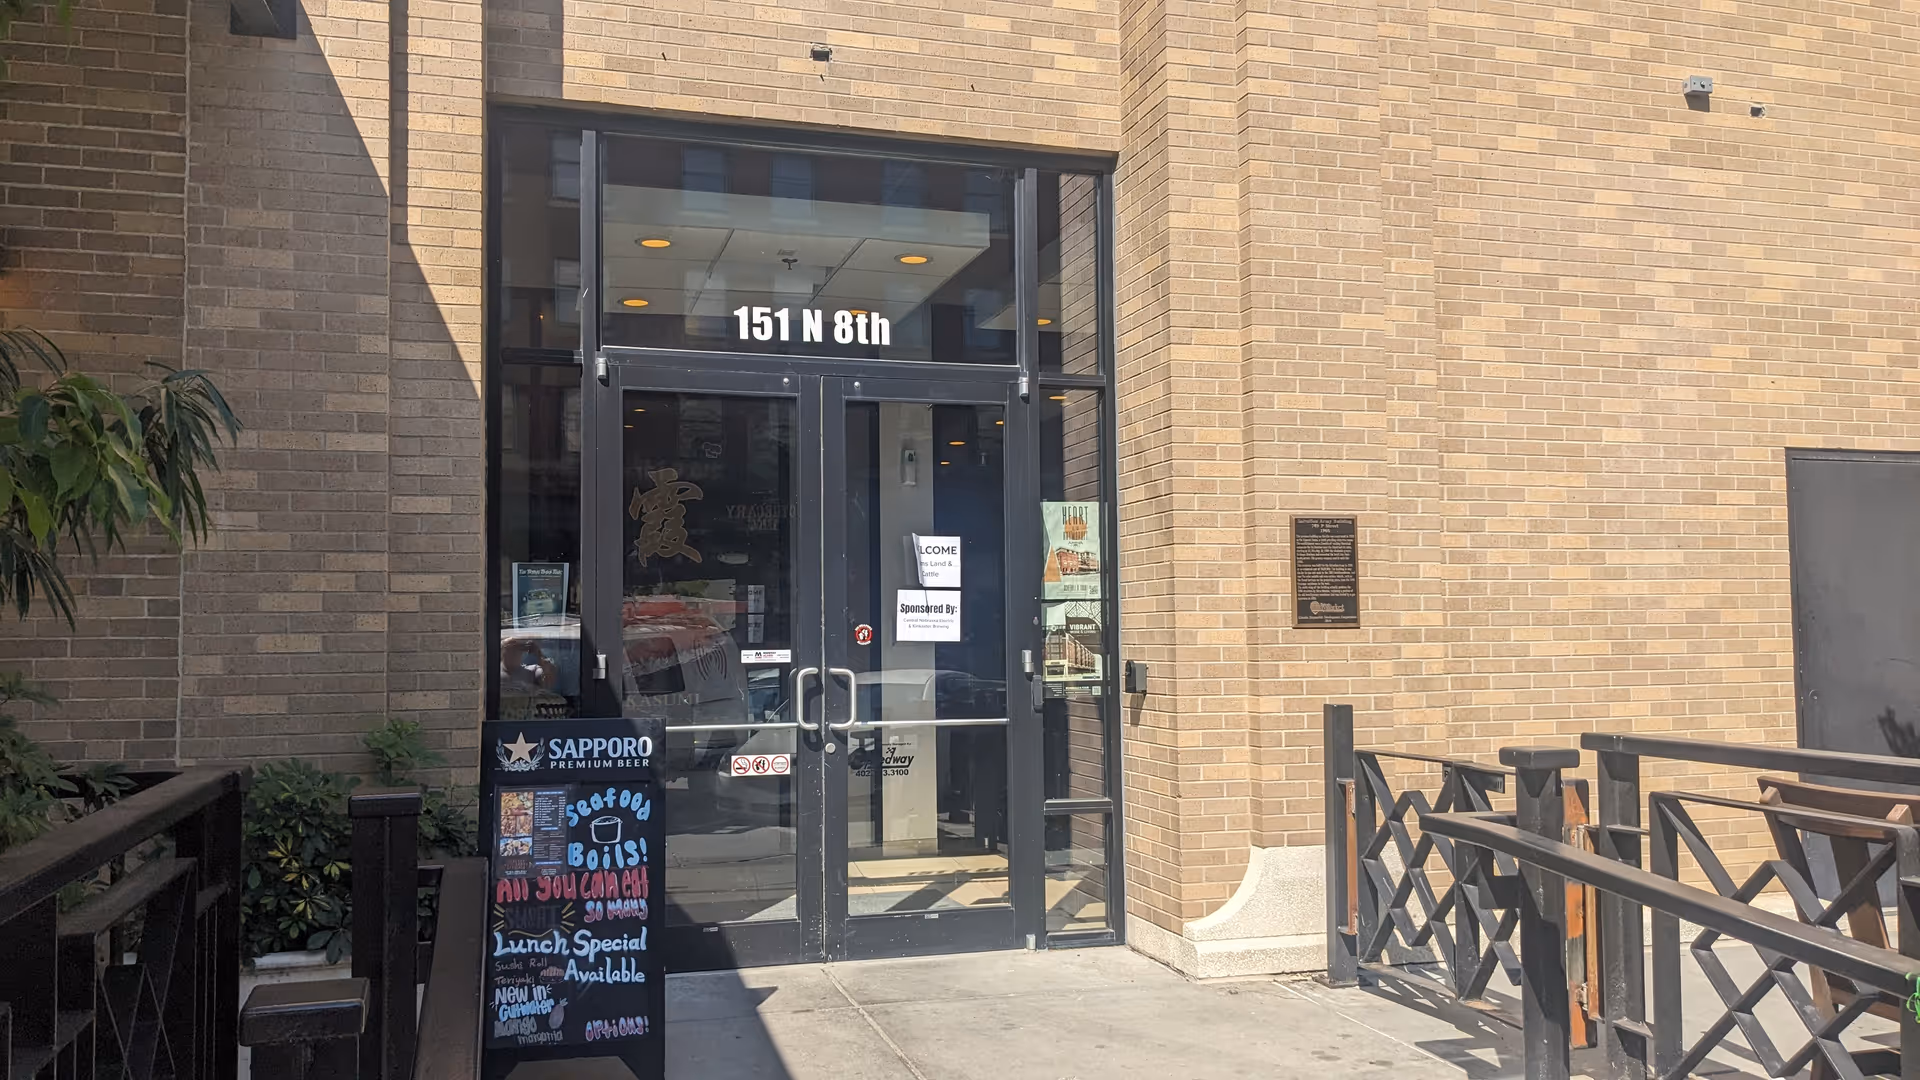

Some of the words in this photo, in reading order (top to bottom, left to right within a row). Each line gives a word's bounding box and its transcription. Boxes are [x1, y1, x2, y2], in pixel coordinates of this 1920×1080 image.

[733, 305, 790, 342] 151
[802, 308, 823, 343] N
[833, 309, 891, 346] 8th
[1062, 505, 1089, 525] HEART
[918, 545, 958, 555] LCOME
[922, 570, 940, 578] Cattle
[900, 603, 944, 615] Sponsored
[945, 604, 958, 616] By:
[1069, 623, 1096, 631] VIBRANT
[625, 693, 701, 708] KASUMI
[548, 736, 653, 760] SAPPORO
[550, 759, 613, 769] PREMIUM
[617, 758, 650, 768] BEER
[566, 787, 651, 827] Seafood
[568, 837, 648, 871] Boils!
[493, 929, 570, 957] Lunch
[573, 926, 648, 963] Special
[495, 958, 523, 972] Sushi
[529, 957, 548, 968] Roll
[564, 957, 646, 984] Available
[494, 973, 535, 987] Teriyaki
[533, 984, 548, 1001] in
